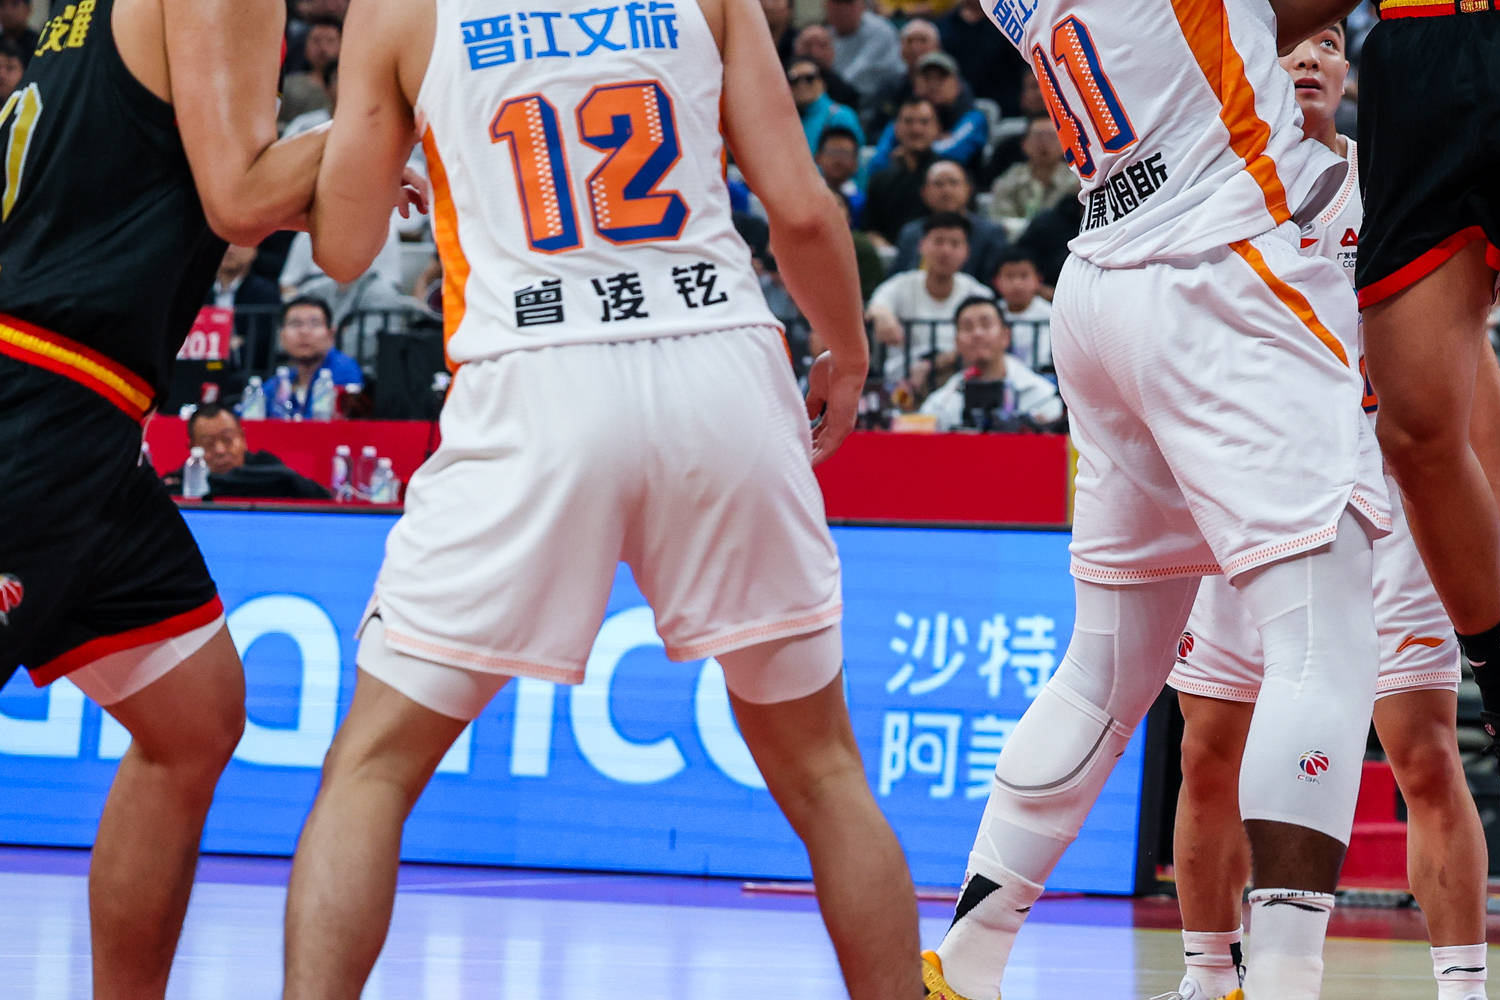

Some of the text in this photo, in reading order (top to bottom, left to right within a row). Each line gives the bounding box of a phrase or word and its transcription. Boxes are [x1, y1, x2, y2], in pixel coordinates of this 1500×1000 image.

[460, 0, 679, 70] 晋江文旅
[1031, 13, 1139, 180] 41
[488, 79, 691, 254] 12
[1080, 151, 1168, 233] 廉姆斯
[514, 262, 729, 328] 曾凌铉
[885, 611, 1056, 698] 沙特
